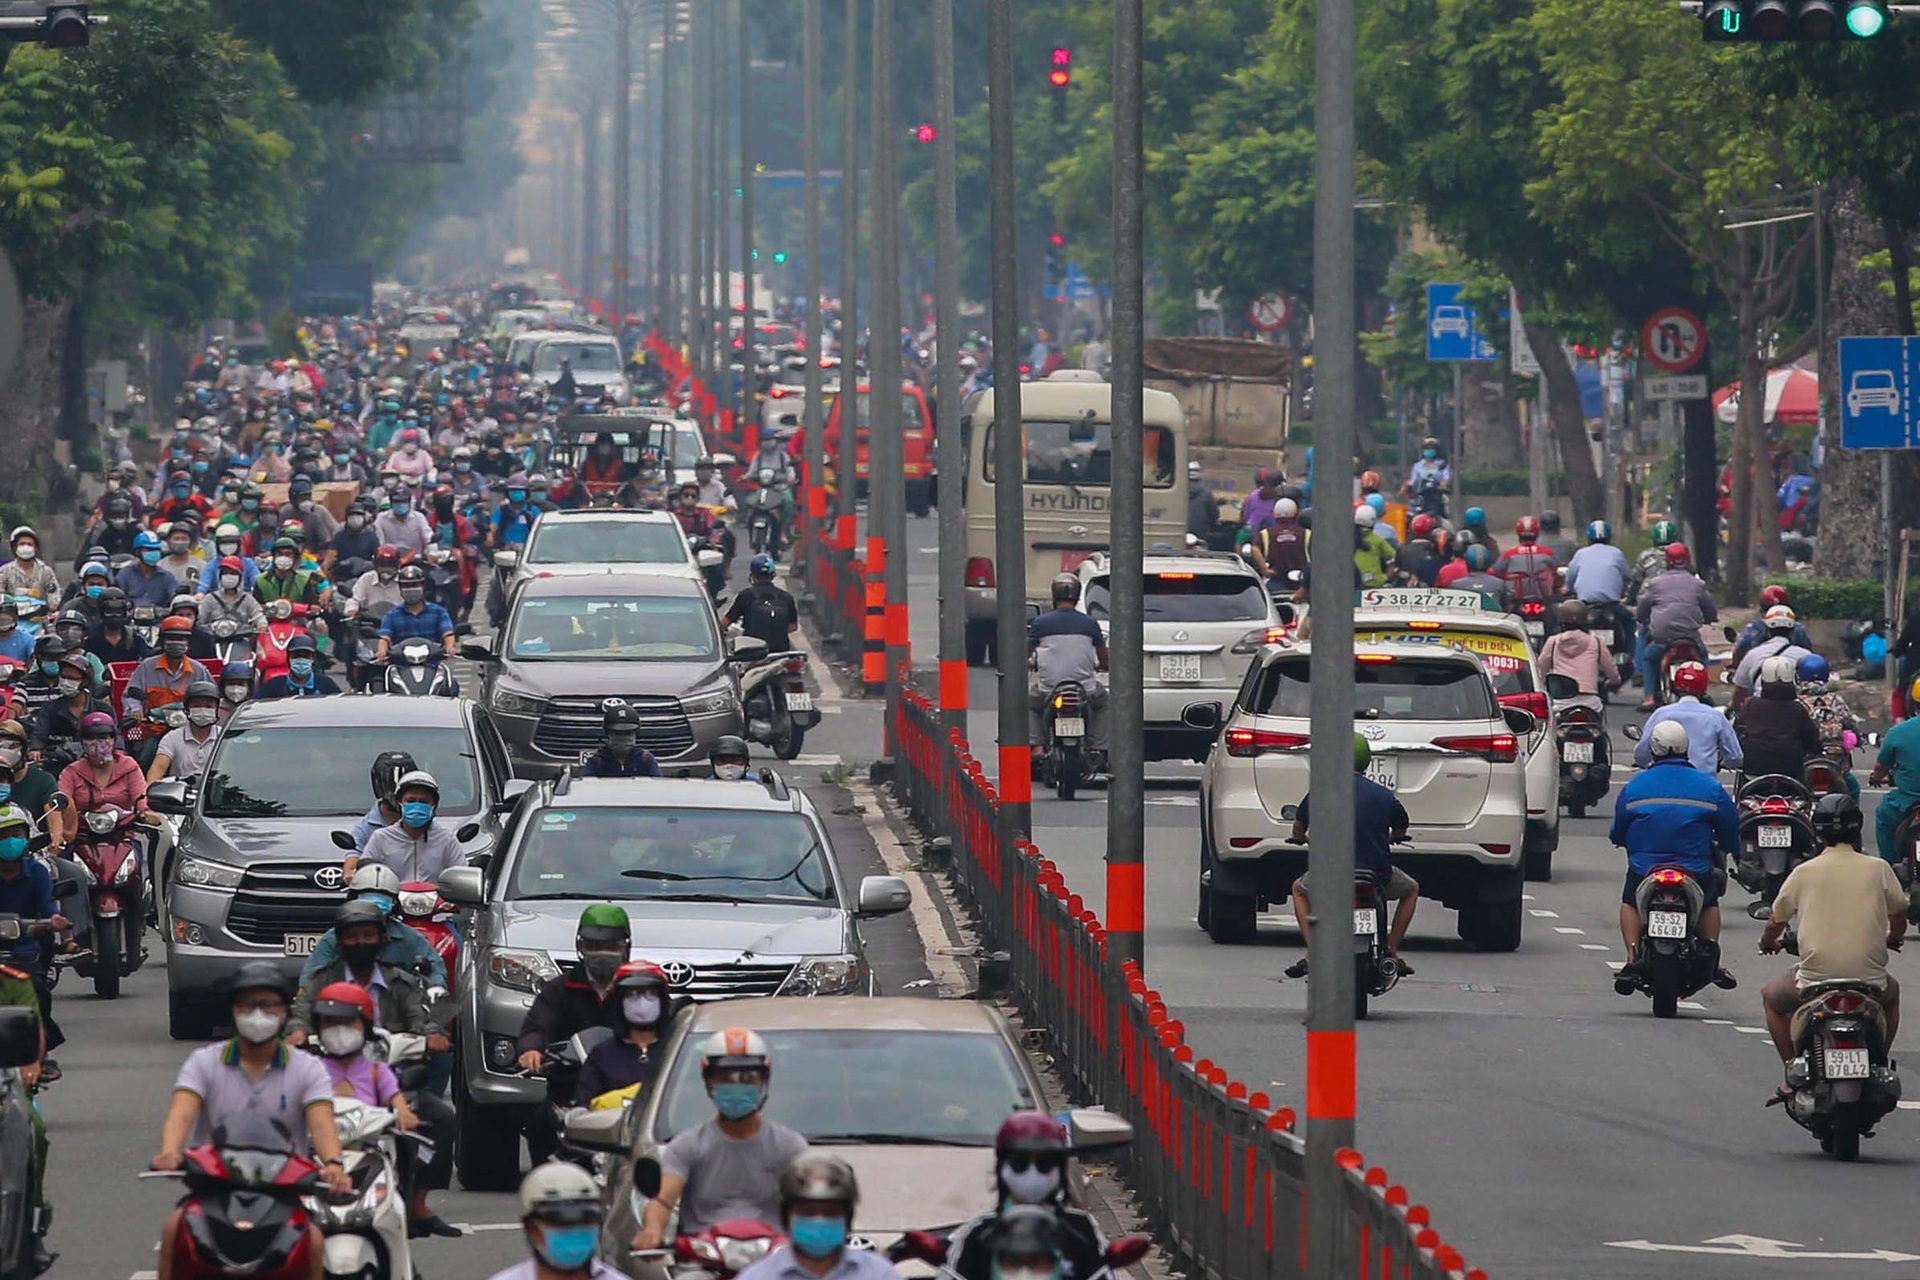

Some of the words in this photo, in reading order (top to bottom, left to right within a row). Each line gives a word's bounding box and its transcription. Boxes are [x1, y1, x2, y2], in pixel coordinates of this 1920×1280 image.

[1390, 594, 1430, 606] 38.27
[1436, 595, 1452, 606] 27
[1458, 596, 1477, 608] 27
[1488, 655, 1519, 670] 10631
[1654, 913, 1682, 925] 59-S2
[1831, 1051, 1861, 1063] 59-L1
